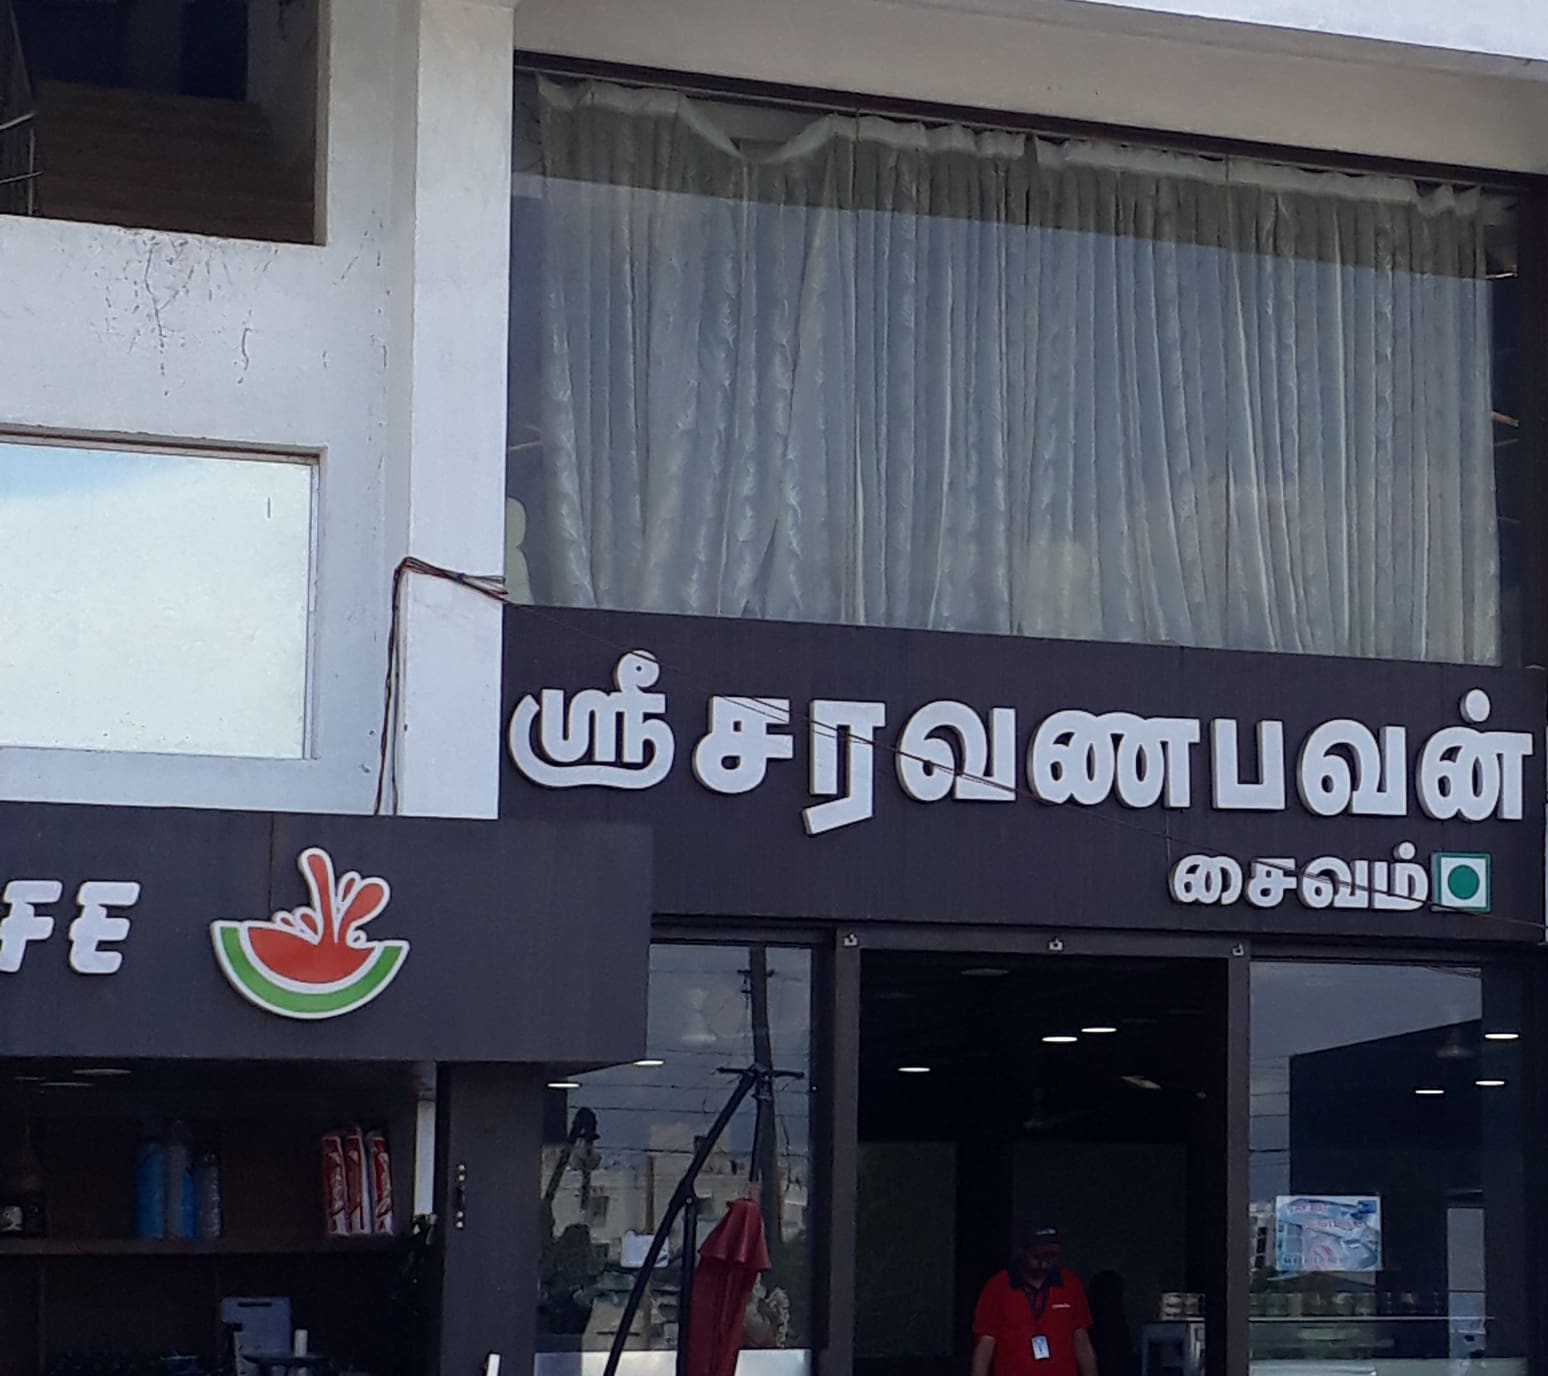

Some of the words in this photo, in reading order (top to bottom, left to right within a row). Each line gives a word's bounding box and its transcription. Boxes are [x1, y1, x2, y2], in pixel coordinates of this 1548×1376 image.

[508, 648, 675, 791] ஸ்ரீ
[694, 688, 1535, 836] சரவணபவன்
[1169, 841, 1430, 912] சைவம்
